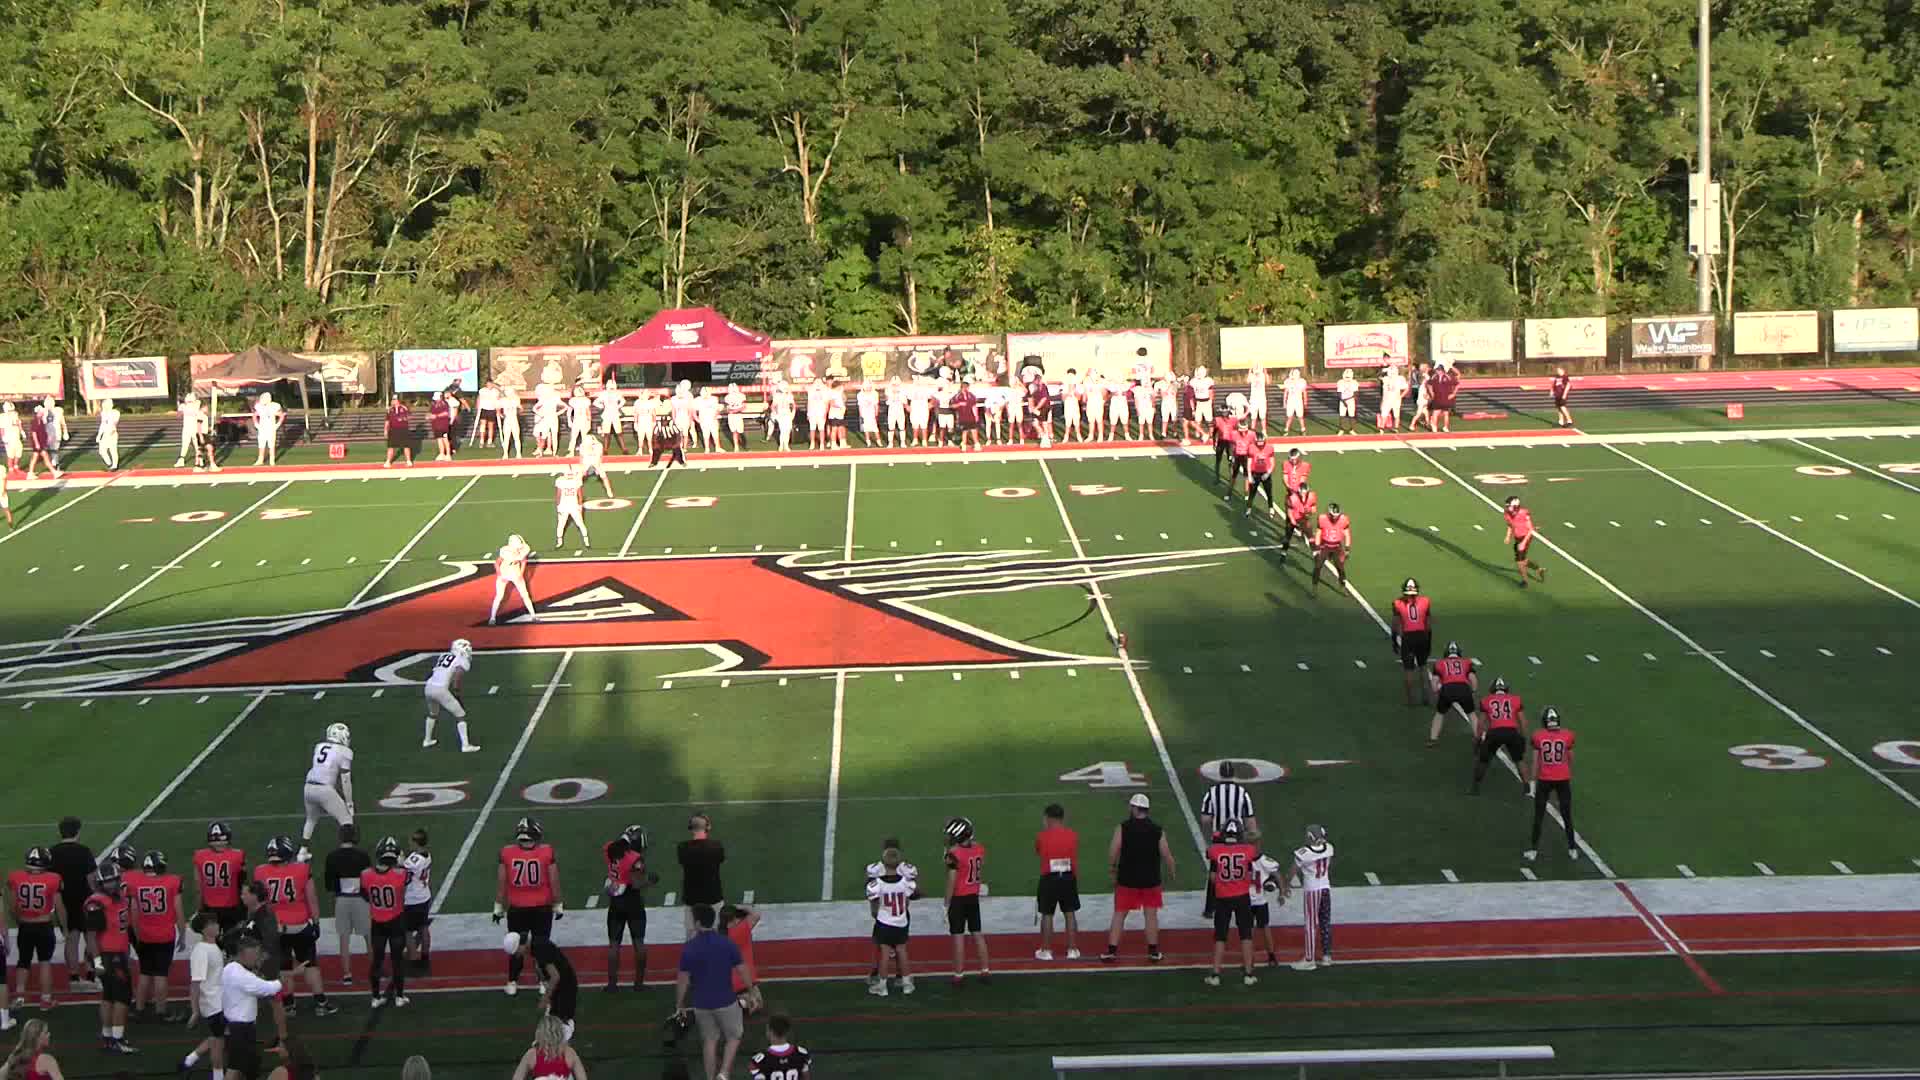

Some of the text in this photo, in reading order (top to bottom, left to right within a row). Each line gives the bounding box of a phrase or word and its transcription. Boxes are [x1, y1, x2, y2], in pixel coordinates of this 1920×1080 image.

[1409, 602, 1419, 622] 0
[1489, 699, 1512, 720] 34
[316, 745, 331, 764] 5
[1542, 740, 1564, 764] 28
[203, 861, 231, 888] 94
[512, 859, 540, 886] 70
[1218, 853, 1245, 882] 35
[19, 882, 46, 910] 95
[138, 886, 167, 914] 53
[267, 877, 297, 904] 74
